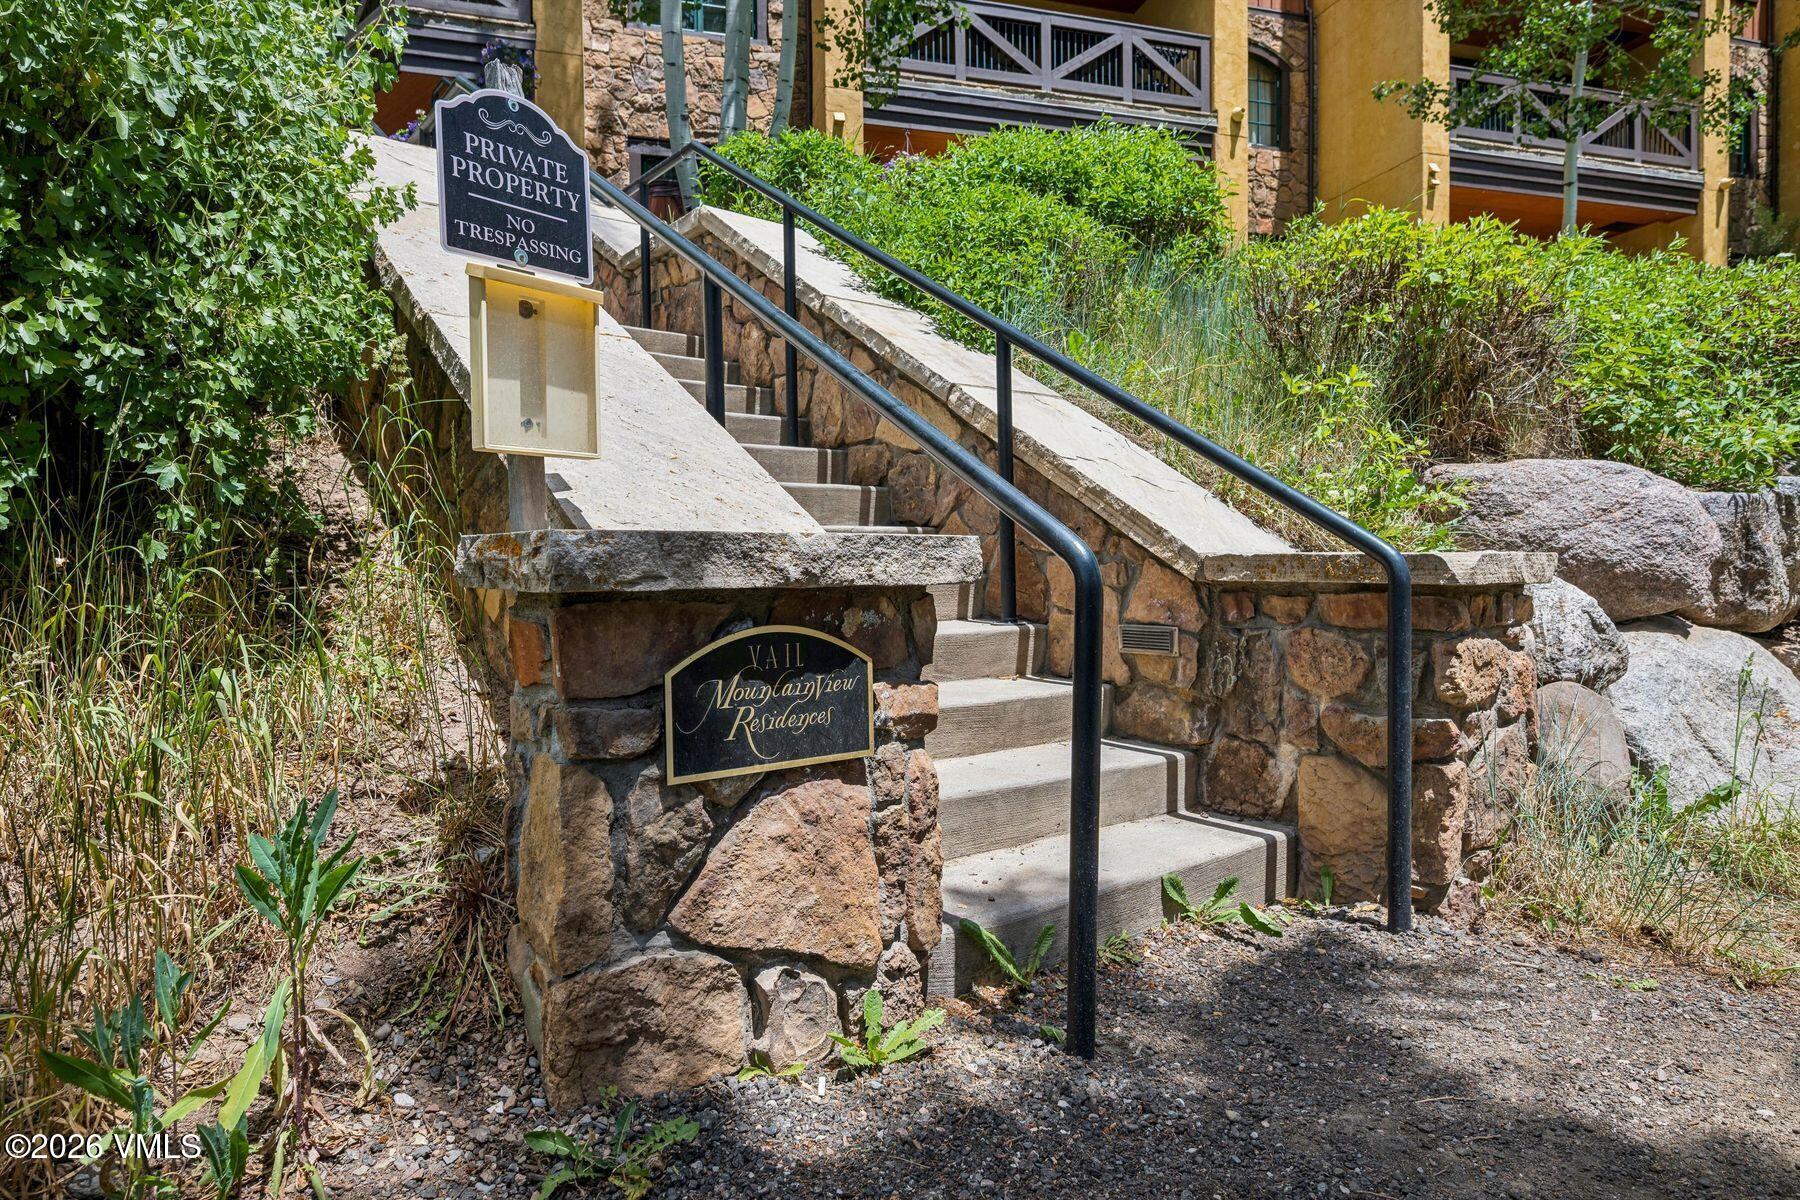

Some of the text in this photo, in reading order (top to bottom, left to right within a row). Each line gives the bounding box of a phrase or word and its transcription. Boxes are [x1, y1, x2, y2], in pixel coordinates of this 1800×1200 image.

[463, 131, 569, 184] PRIVATE
[450, 154, 581, 213] PROPERTY
[454, 219, 582, 264] TRESPASSING
[506, 213, 535, 234] NO
[749, 642, 804, 669] VAIL
[723, 699, 835, 760] Residences
